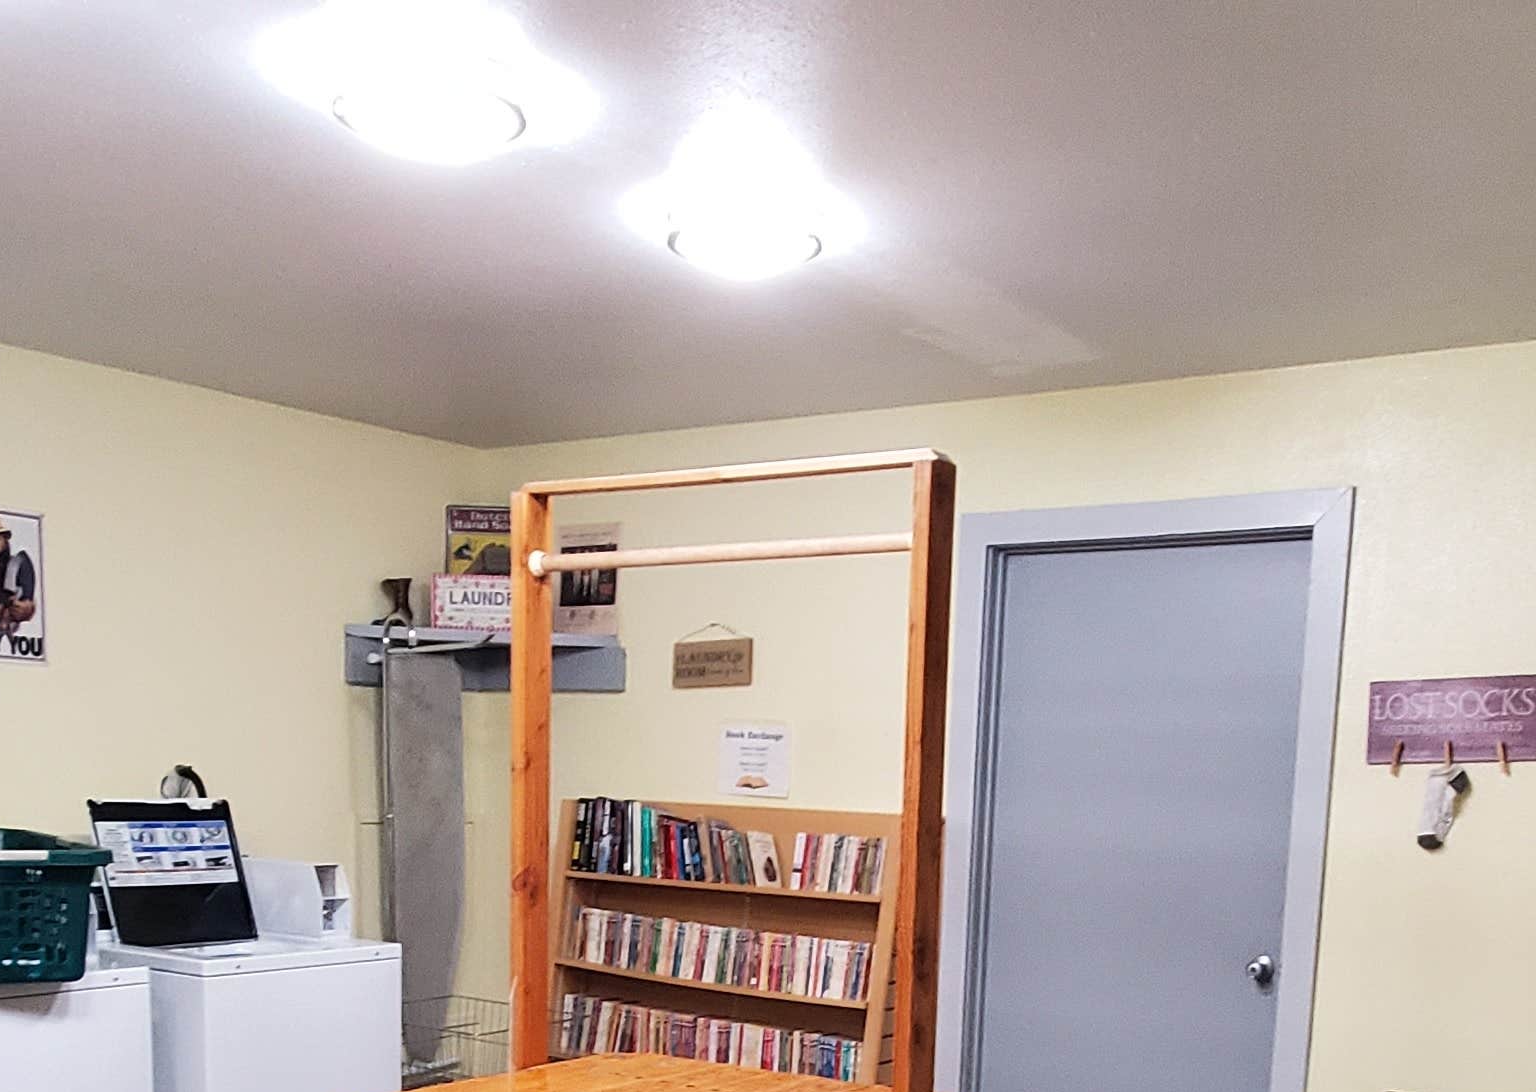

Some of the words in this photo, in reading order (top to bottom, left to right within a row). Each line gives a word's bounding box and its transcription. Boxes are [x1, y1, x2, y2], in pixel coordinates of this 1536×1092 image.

[449, 590, 511, 606] LAUND
[7, 636, 43, 656] YOU
[1372, 691, 1443, 721] LOST
[1443, 687, 1536, 719] SOCKS
